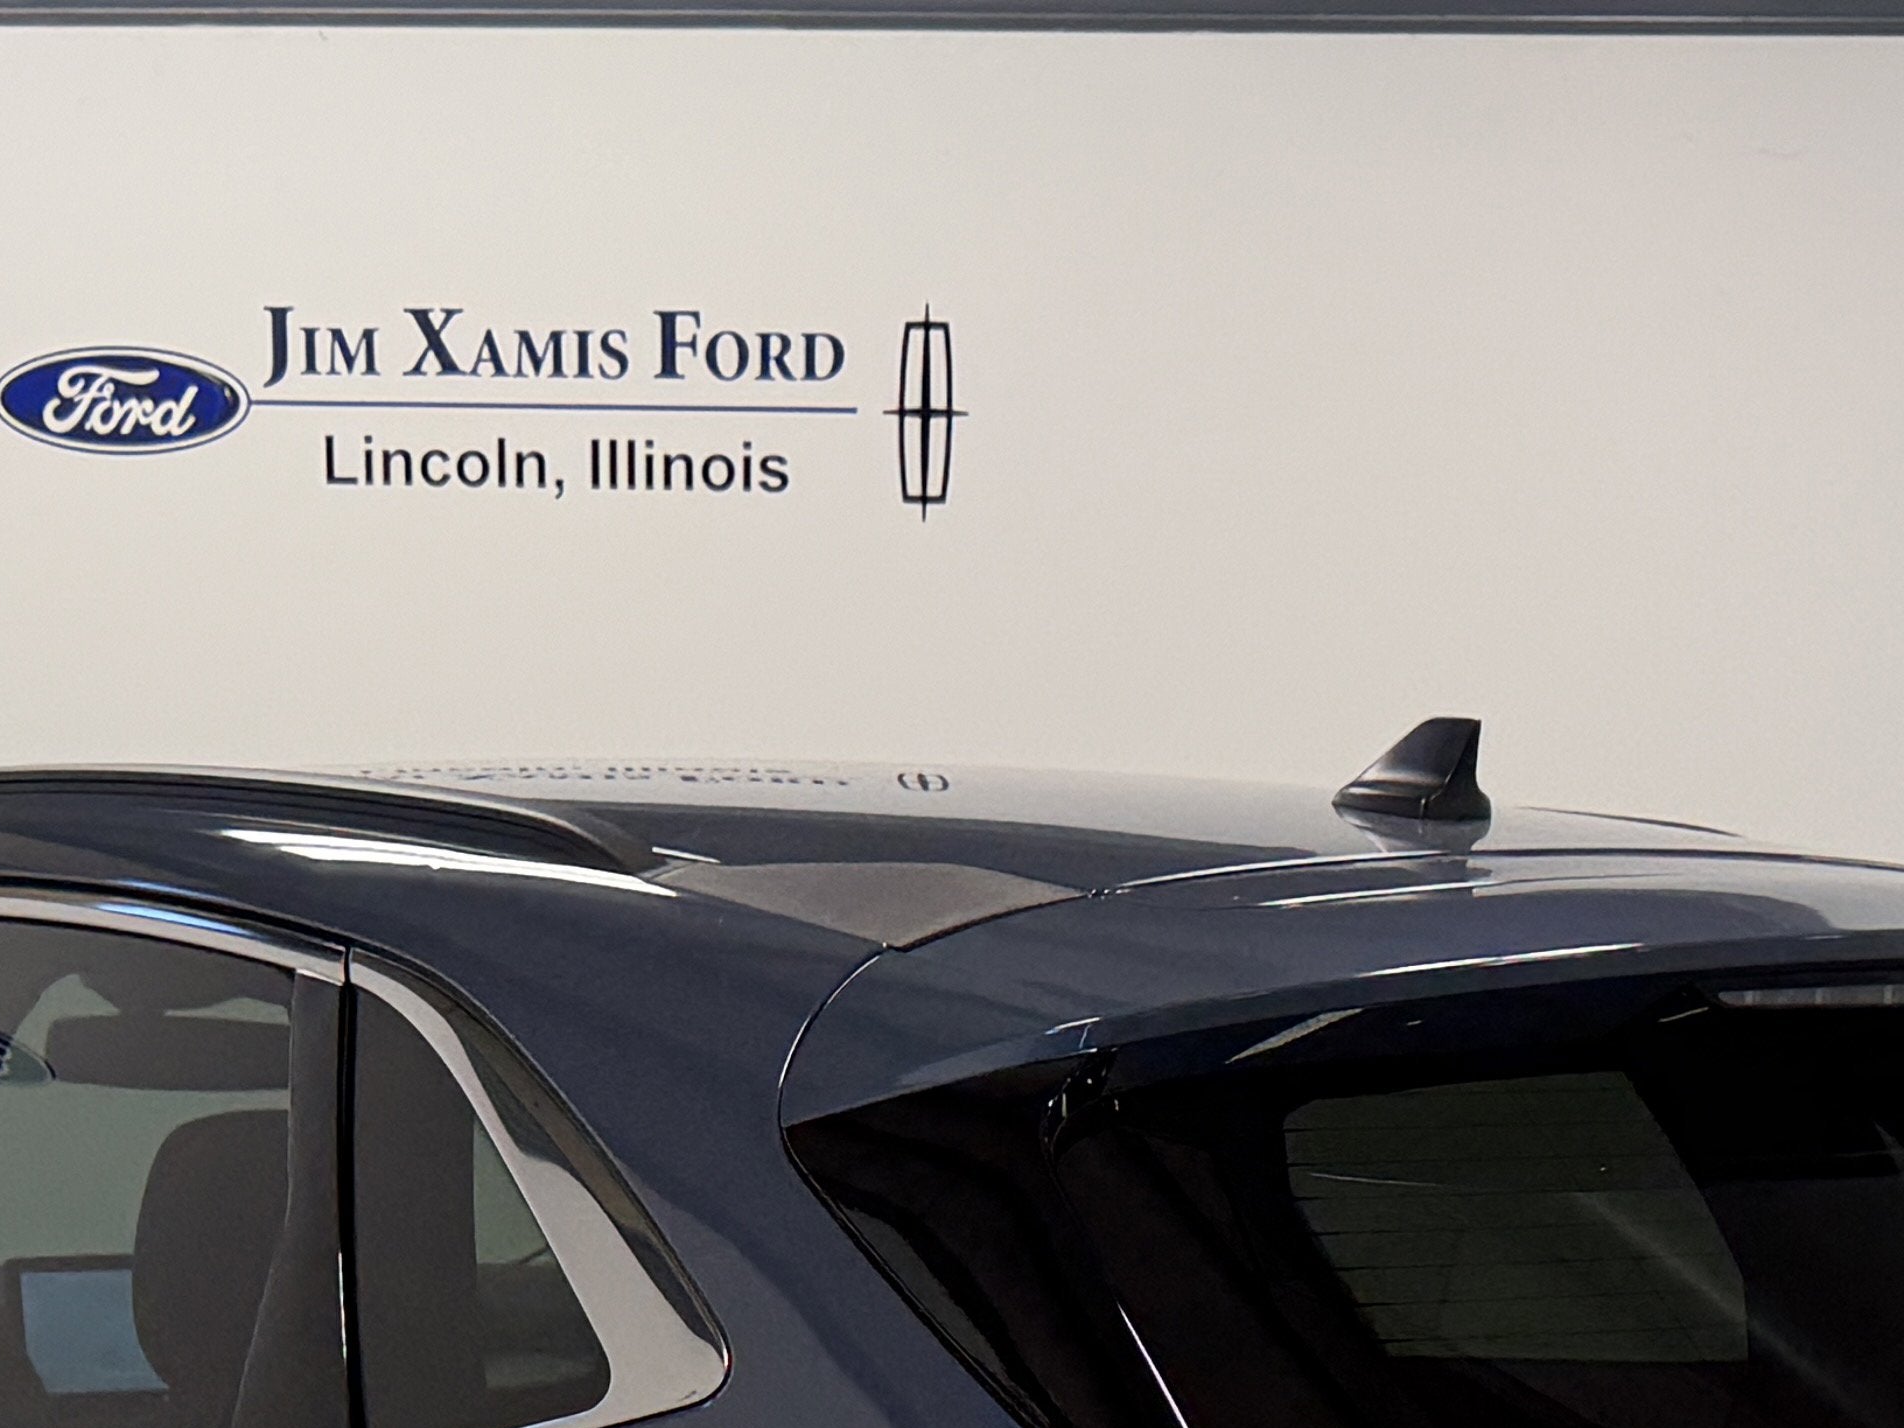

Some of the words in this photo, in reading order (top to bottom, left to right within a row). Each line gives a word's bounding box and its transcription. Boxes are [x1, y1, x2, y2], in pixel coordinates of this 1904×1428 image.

[262, 305, 380, 388] JIM
[401, 307, 630, 381] XAMIS
[652, 309, 846, 382] FORD
[41, 363, 198, 439] Ford
[324, 434, 564, 500] Lincoln,
[590, 438, 790, 494] Illinois
